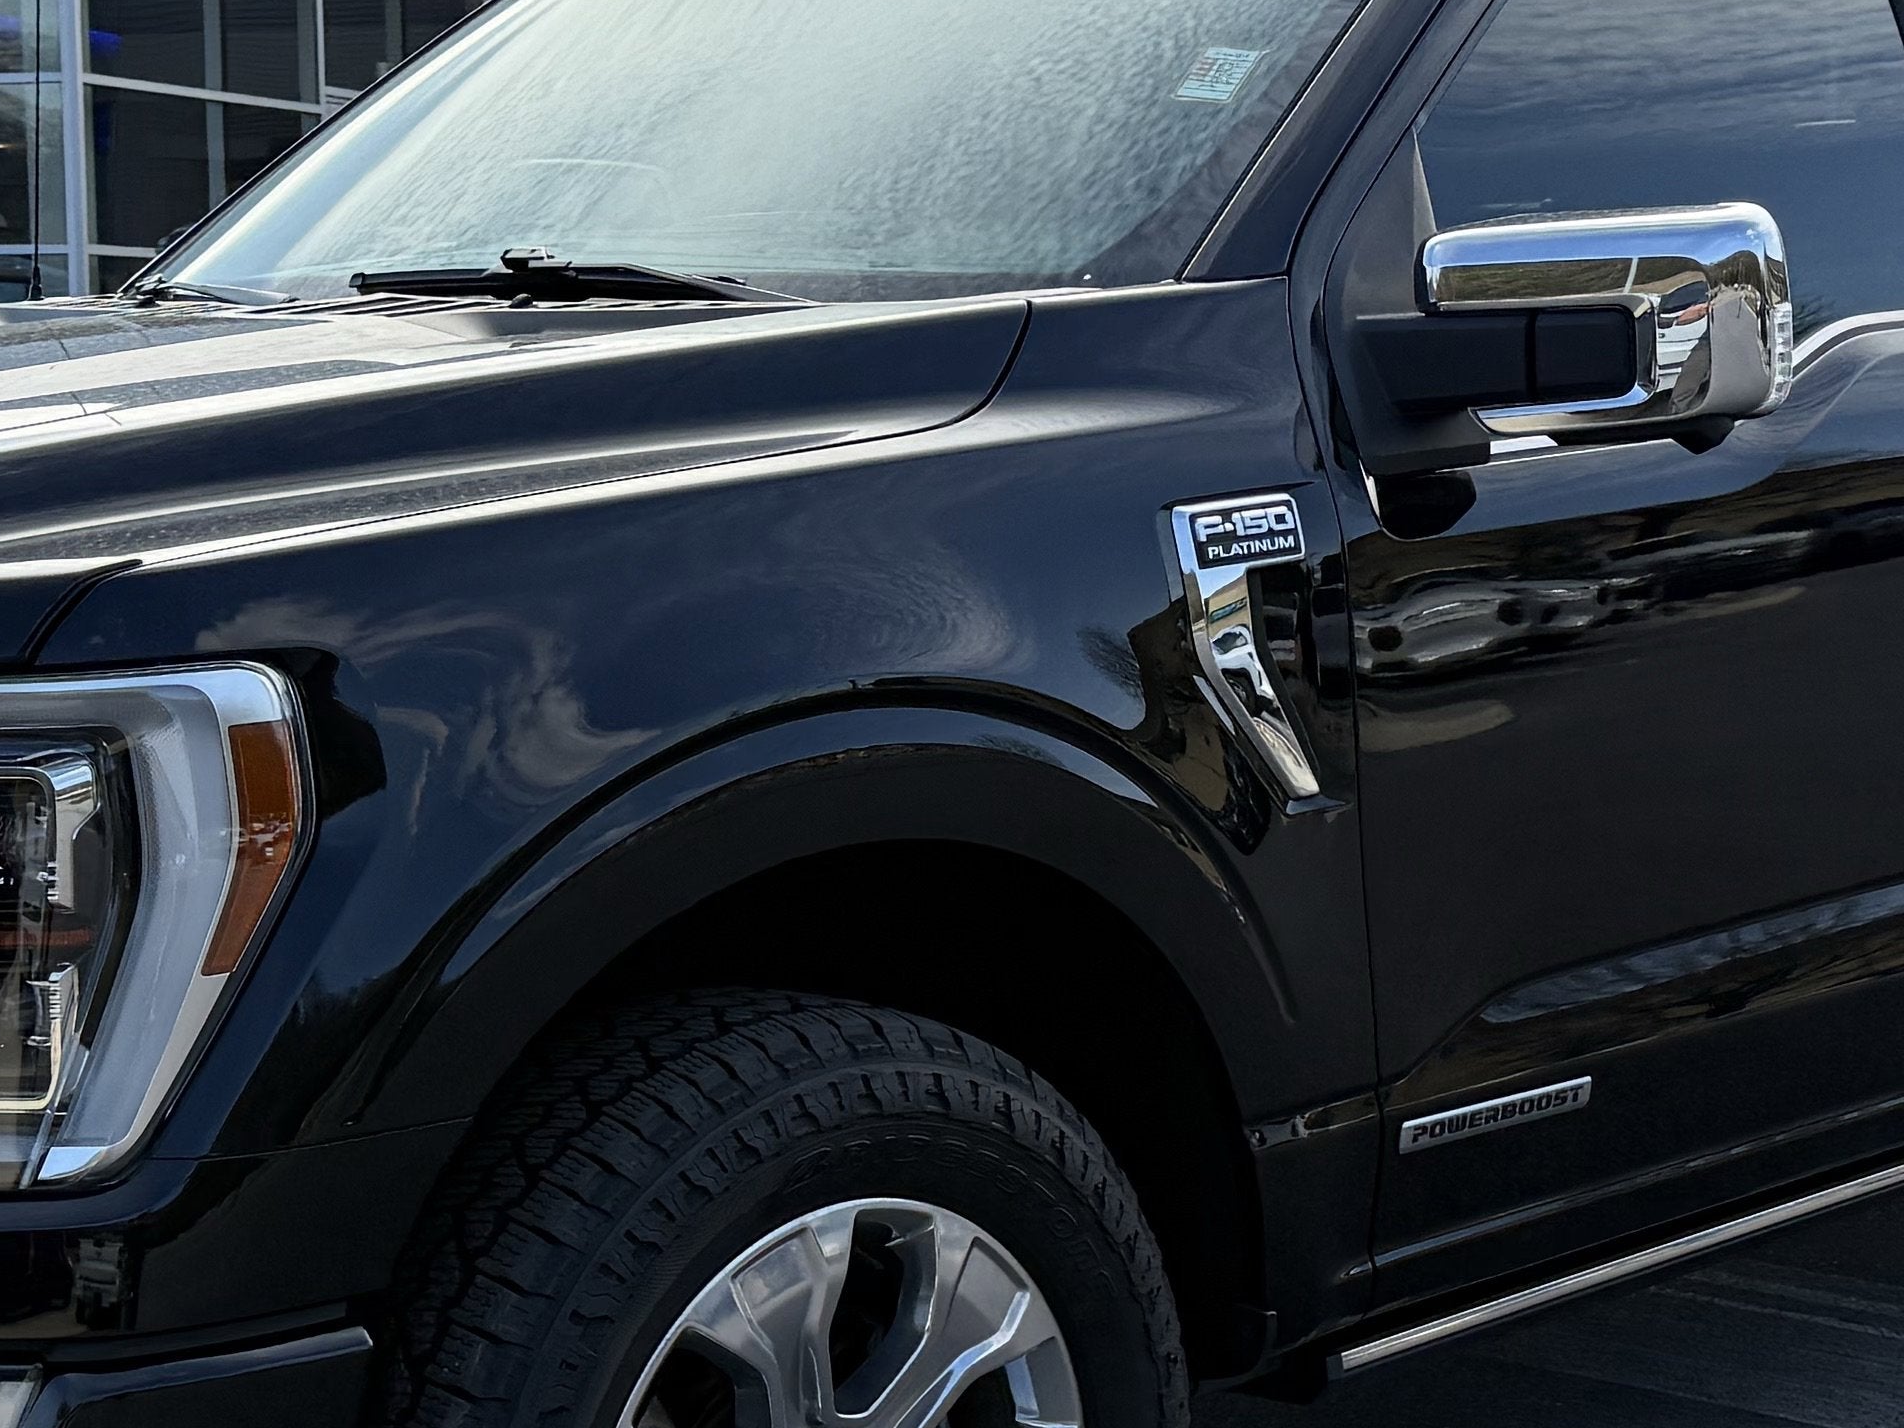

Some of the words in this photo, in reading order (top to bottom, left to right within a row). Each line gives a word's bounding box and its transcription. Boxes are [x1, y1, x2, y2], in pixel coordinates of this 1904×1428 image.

[1195, 505, 1296, 542] F-150
[1207, 535, 1295, 559] PLATINUM
[1411, 1085, 1585, 1144] POWERBOOST
